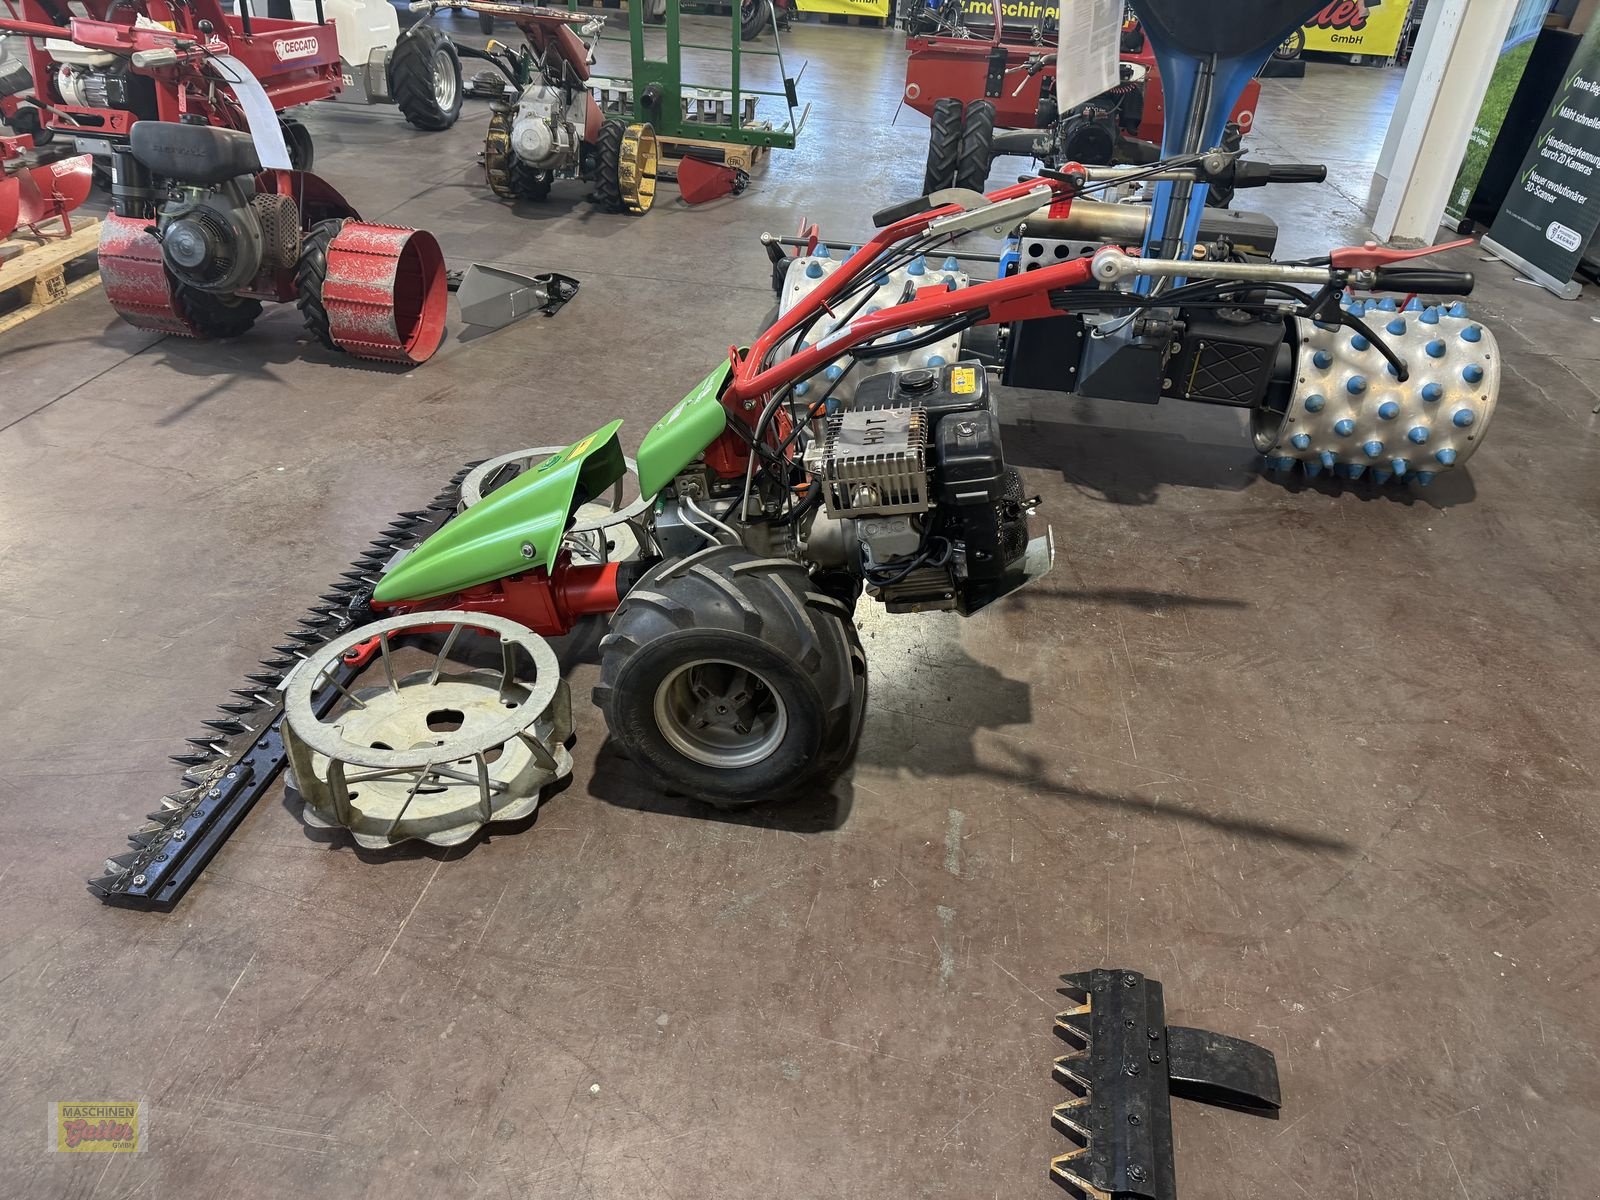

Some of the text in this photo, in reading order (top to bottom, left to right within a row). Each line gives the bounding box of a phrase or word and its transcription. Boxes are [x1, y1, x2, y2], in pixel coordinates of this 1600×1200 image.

[284, 38, 317, 53] CECCATO
[1330, 33, 1364, 45] GmbH
[1573, 76, 1591, 91] Ohne
[1559, 106, 1578, 121] Mäht
[1540, 146, 1593, 176] durch 2D Kameras
[1524, 180, 1558, 204] 3D-Scanner
[1529, 170, 1588, 205] Neuer revolutionärer
